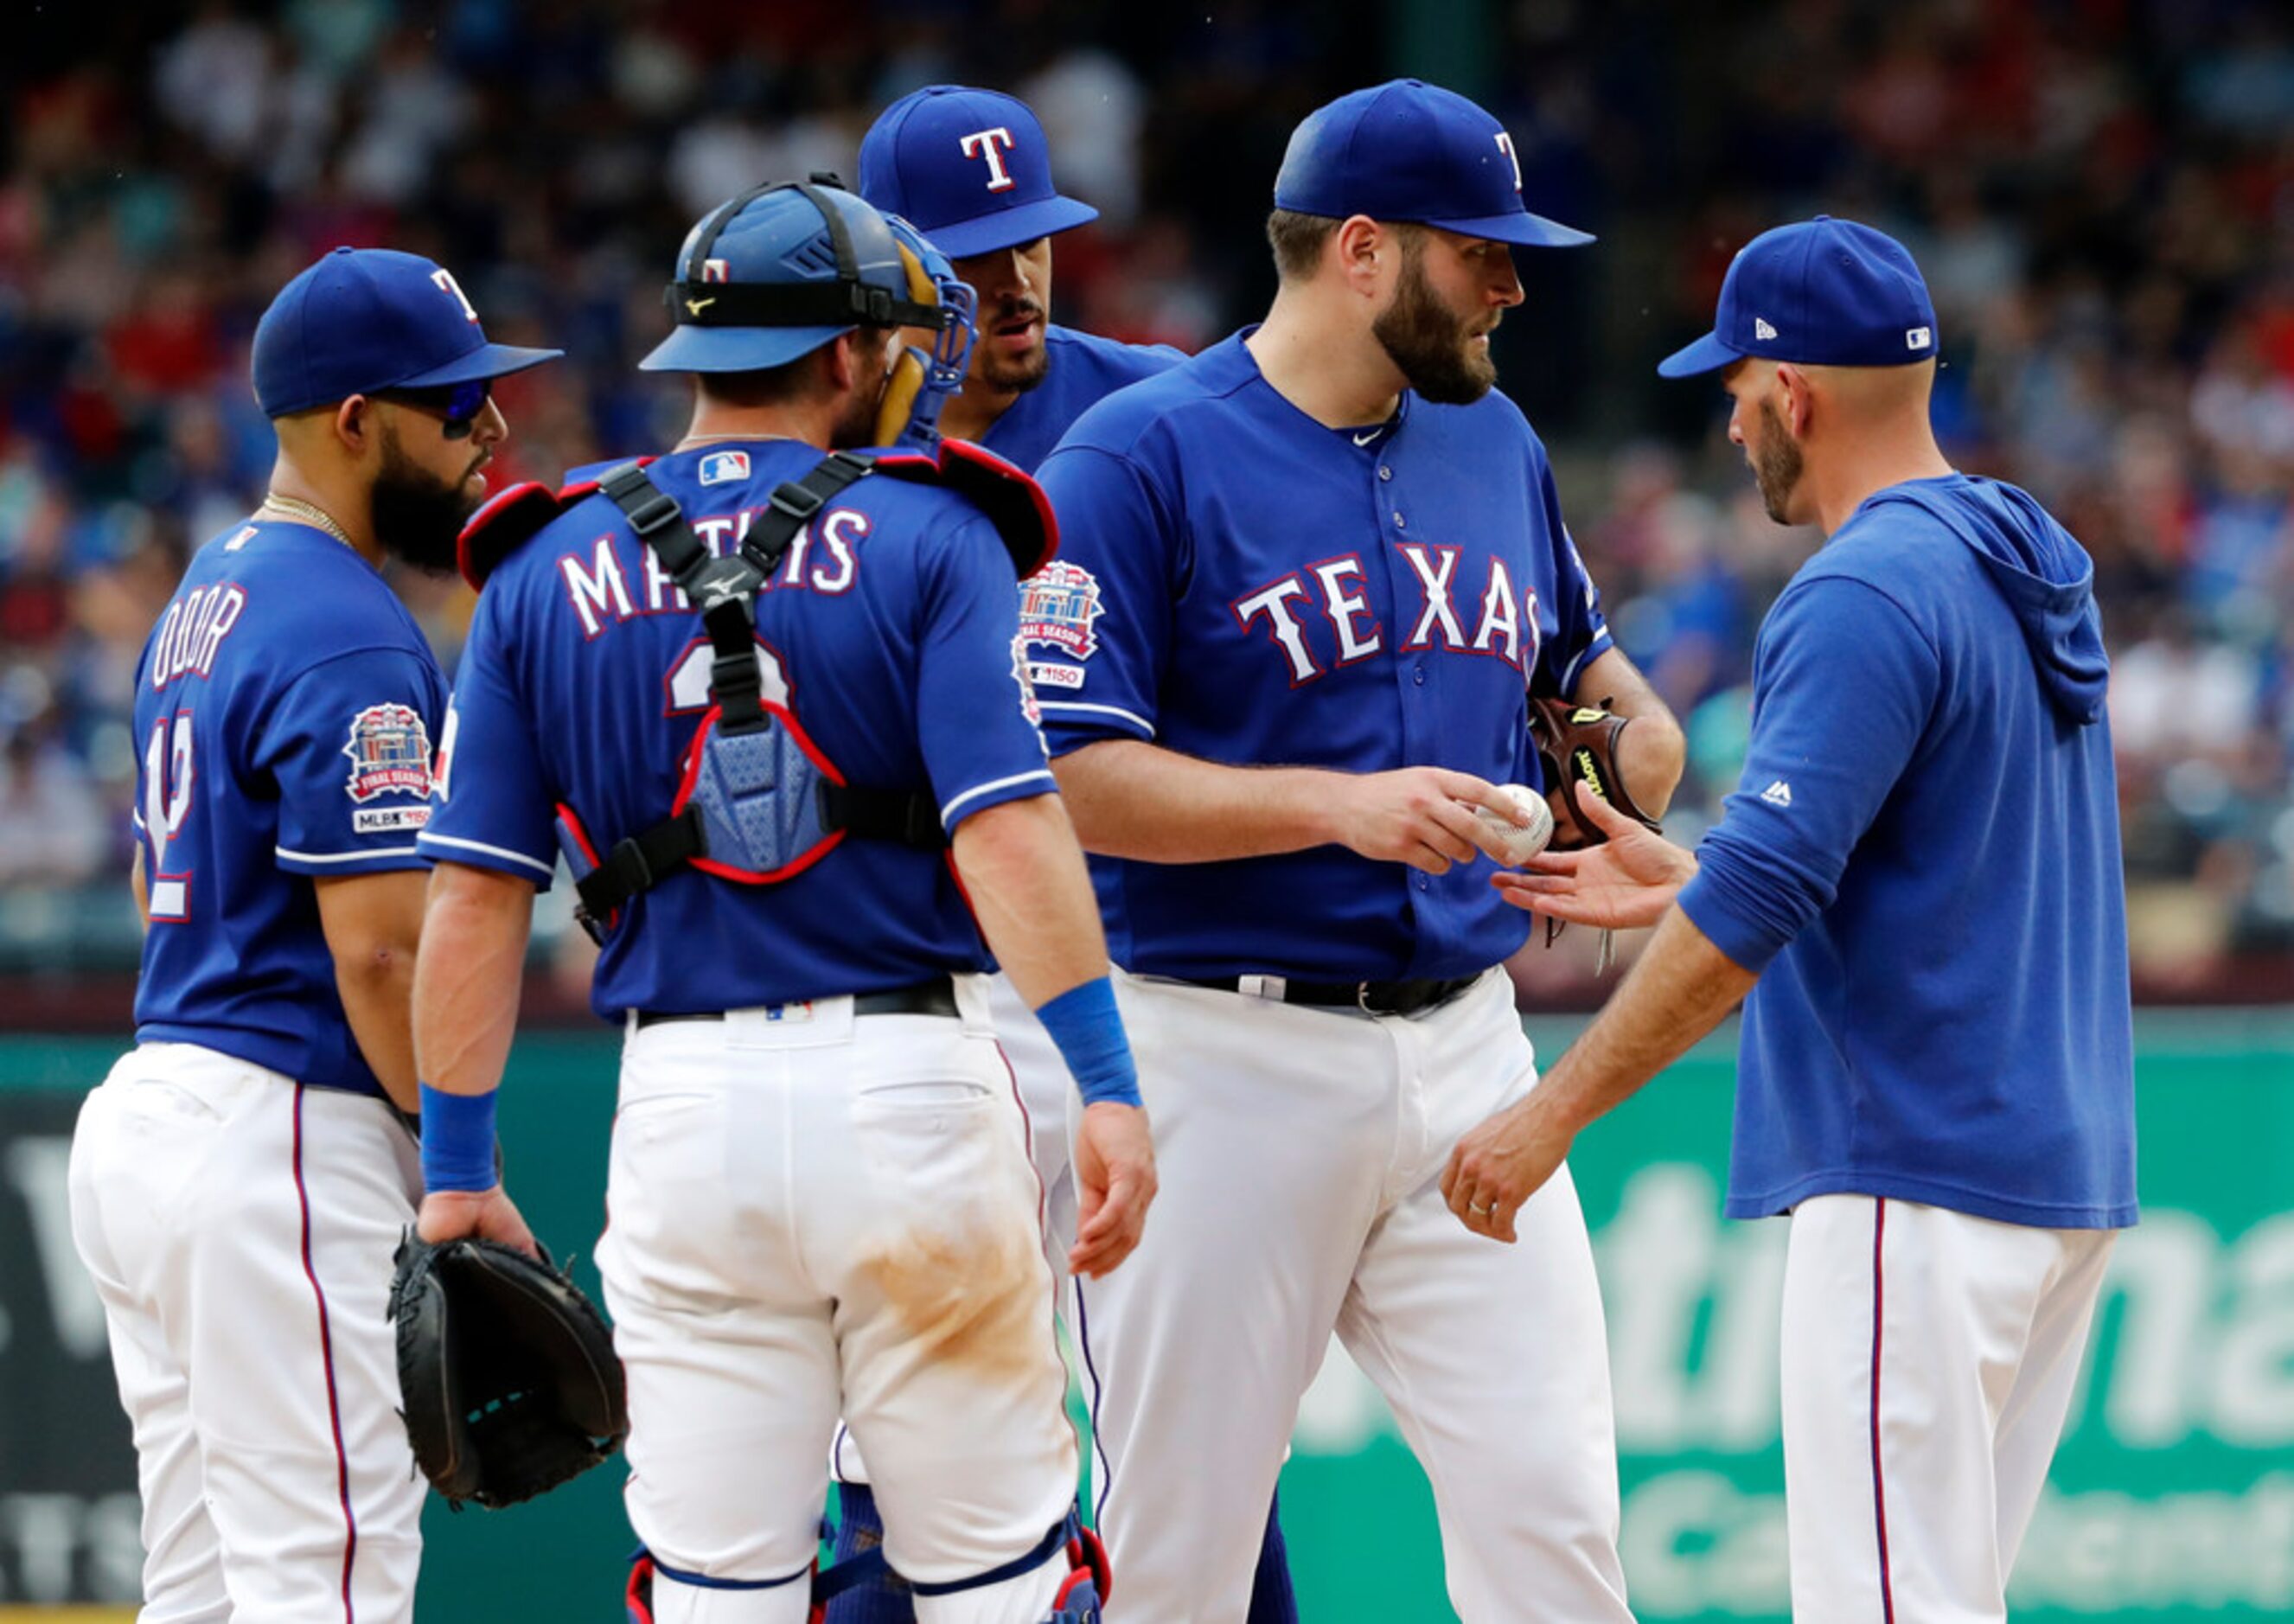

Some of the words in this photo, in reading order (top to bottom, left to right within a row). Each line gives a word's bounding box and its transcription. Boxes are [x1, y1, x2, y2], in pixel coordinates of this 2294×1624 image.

[960, 127, 1016, 195] T
[1493, 131, 1523, 195] T
[430, 267, 481, 326] T
[152, 581, 248, 692] ODOR
